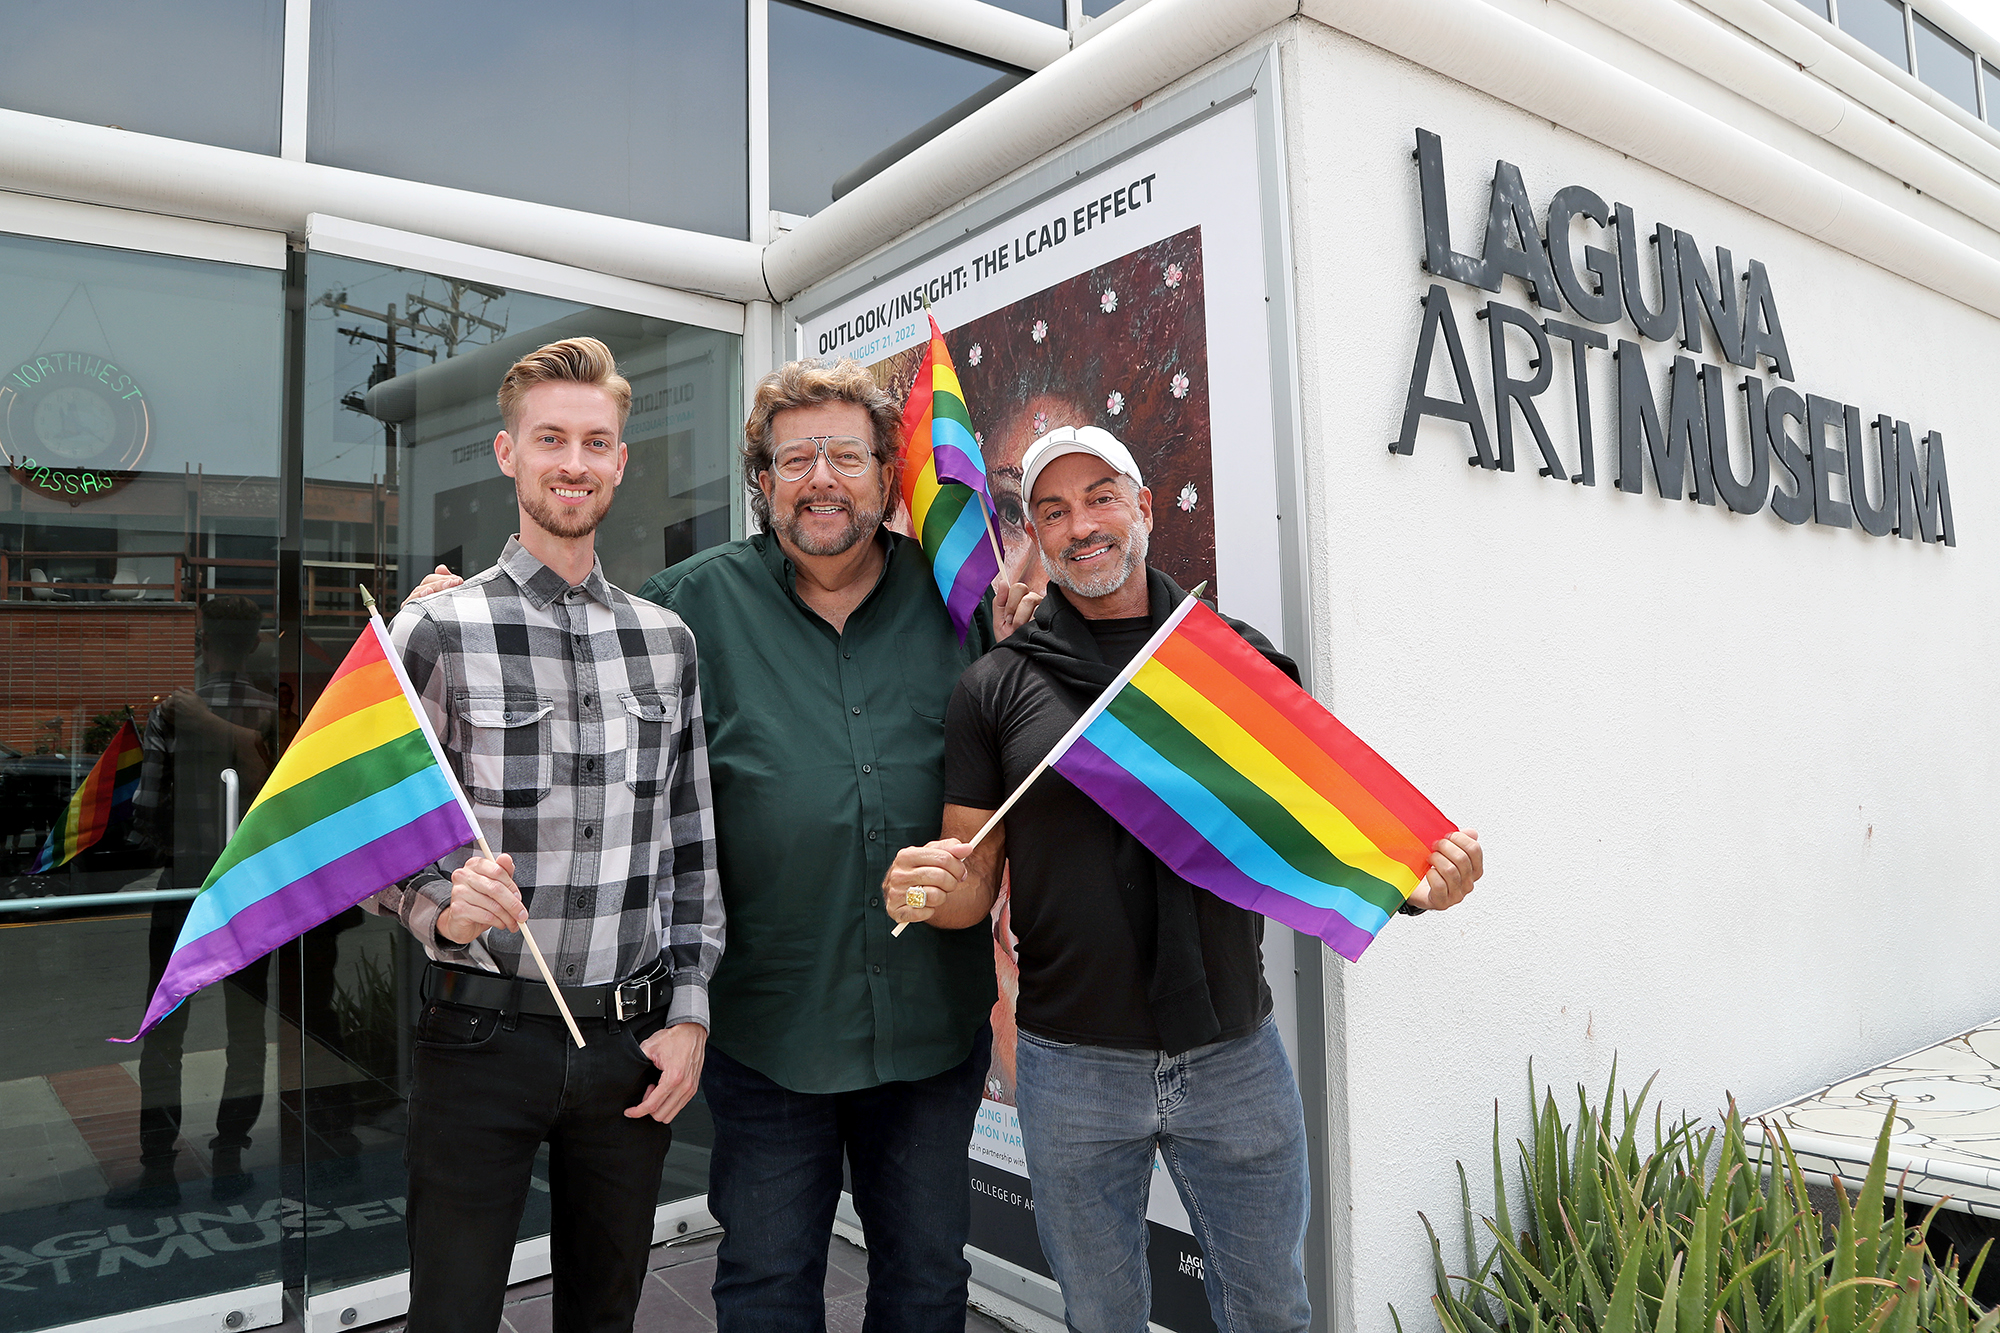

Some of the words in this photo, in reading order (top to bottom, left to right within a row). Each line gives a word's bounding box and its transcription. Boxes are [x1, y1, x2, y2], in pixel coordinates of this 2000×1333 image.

[972, 243, 1009, 283] THE
[1014, 216, 1067, 263] LCAD
[1073, 173, 1157, 237] EFFECT
[1412, 127, 1795, 382] LAGUNA
[882, 334, 893, 349] 21,
[895, 323, 916, 343] 2022
[7, 352, 143, 400] NORTHWEST
[1390, 284, 1608, 487] ART
[1616, 340, 1957, 549] MUSEUM
[1002, 1131, 1025, 1149] VAR
[981, 1147, 1012, 1164] partnership
[1013, 1157, 1026, 1167] with
[970, 1177, 1009, 1203] COLLEGE
[1010, 1192, 1022, 1207] OF
[1178, 1262, 1196, 1278] ART
